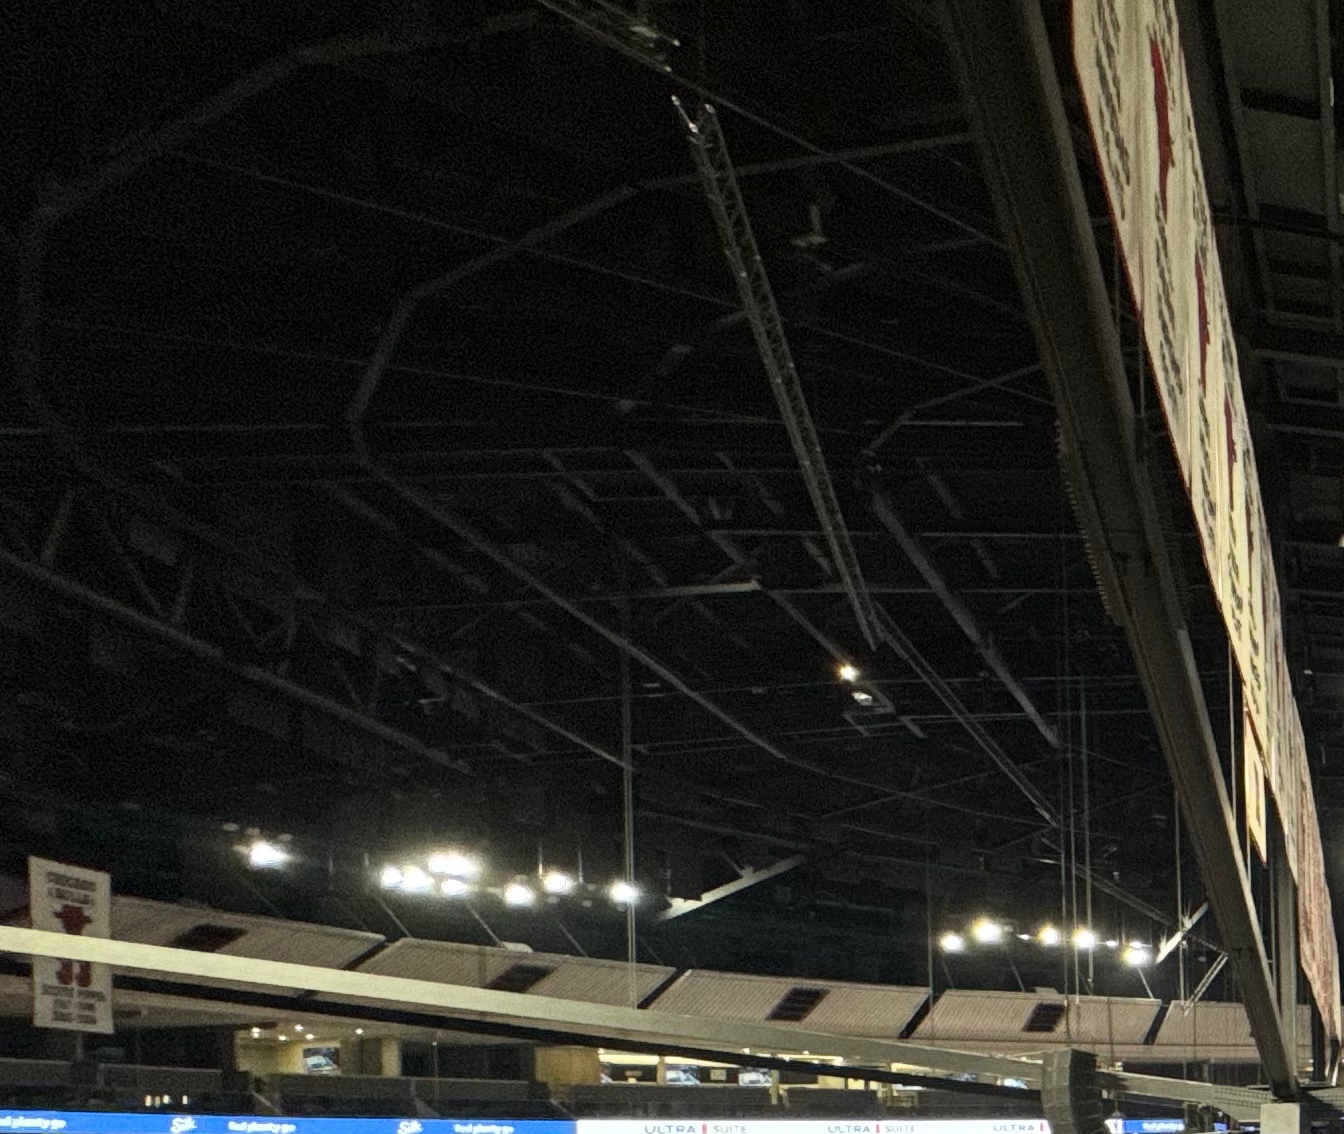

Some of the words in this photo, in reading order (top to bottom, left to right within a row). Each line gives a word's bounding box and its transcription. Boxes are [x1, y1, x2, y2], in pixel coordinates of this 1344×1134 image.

[644, 1124, 697, 1134] ULTRA
[712, 1124, 748, 1134] SUITE
[827, 1124, 871, 1134] ULTRA
[885, 1124, 917, 1134] SUITE
[992, 1123, 1035, 1133] ULTRA
